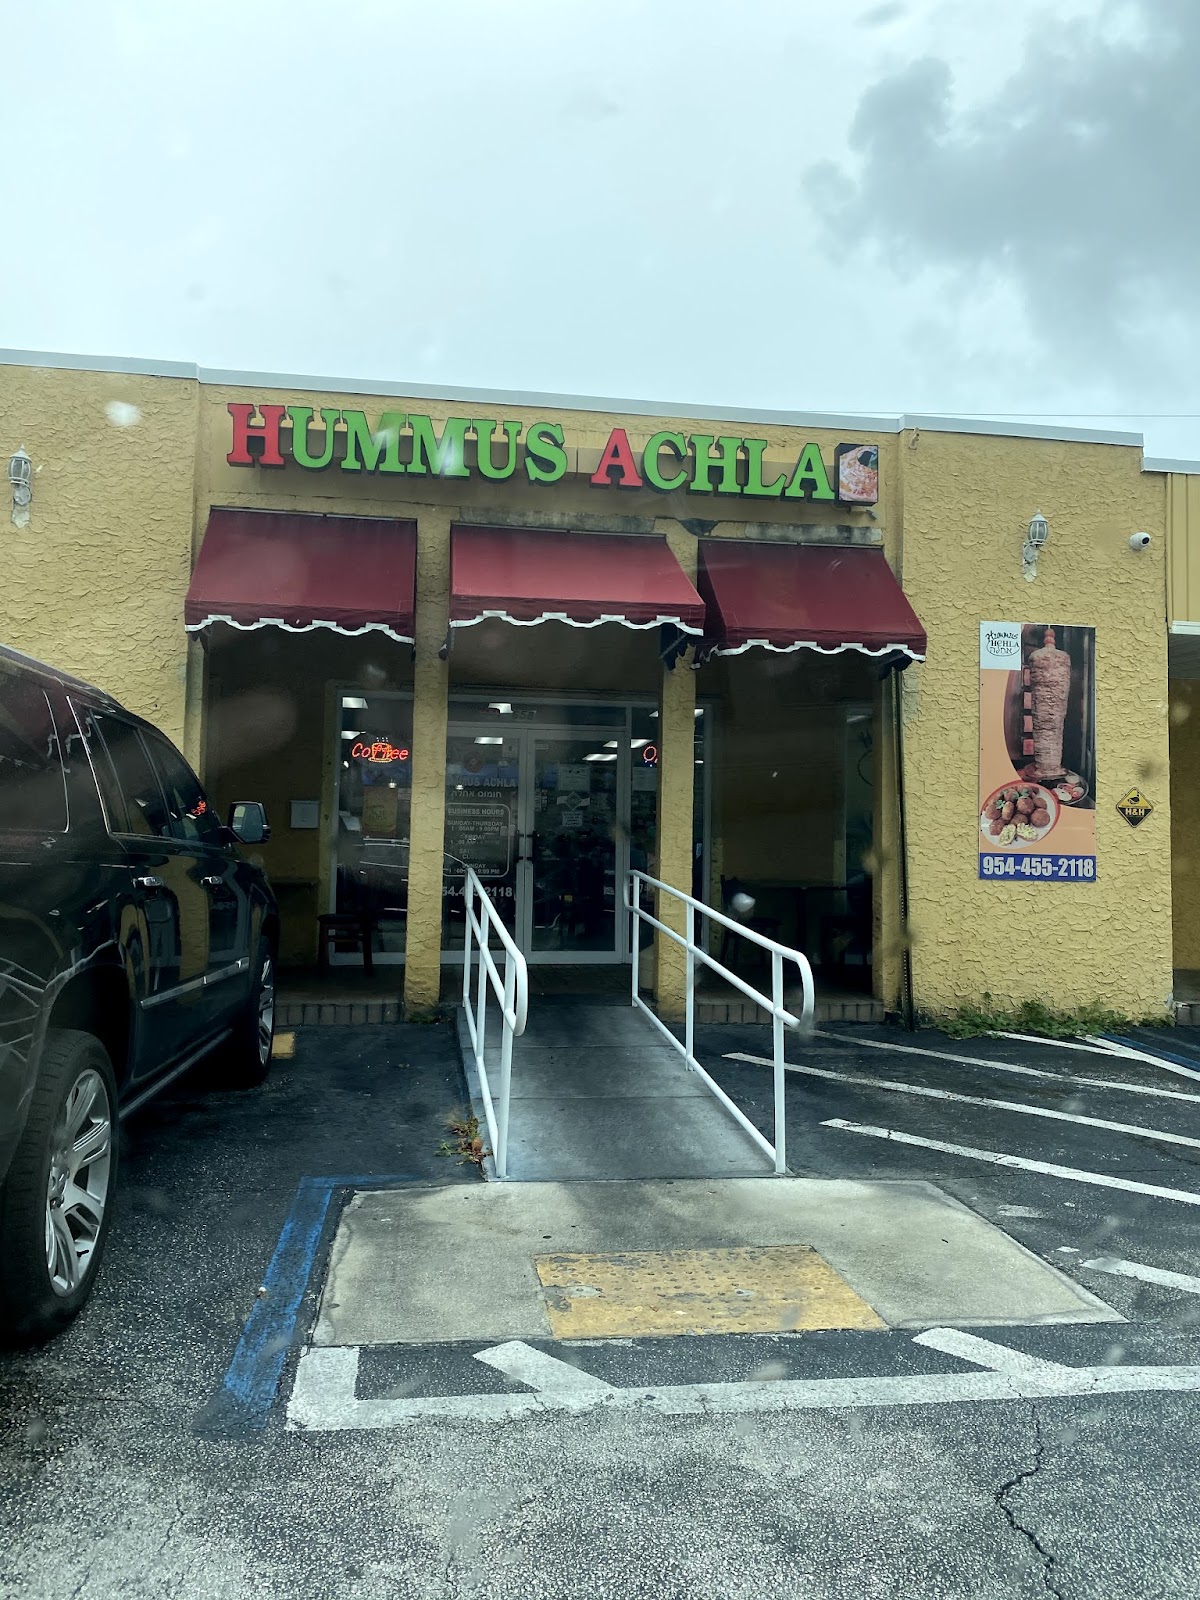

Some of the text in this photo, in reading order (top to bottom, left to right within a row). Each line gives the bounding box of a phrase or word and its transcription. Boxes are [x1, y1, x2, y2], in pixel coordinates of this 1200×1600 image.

[226, 402, 837, 502] HUMMUS ACHLA
[352, 742, 409, 761] Coffee
[483, 777, 516, 788] ACHLA
[481, 808, 504, 816] HOURS
[1125, 808, 1145, 816] H&H
[983, 856, 1094, 878] 954-455-2118
